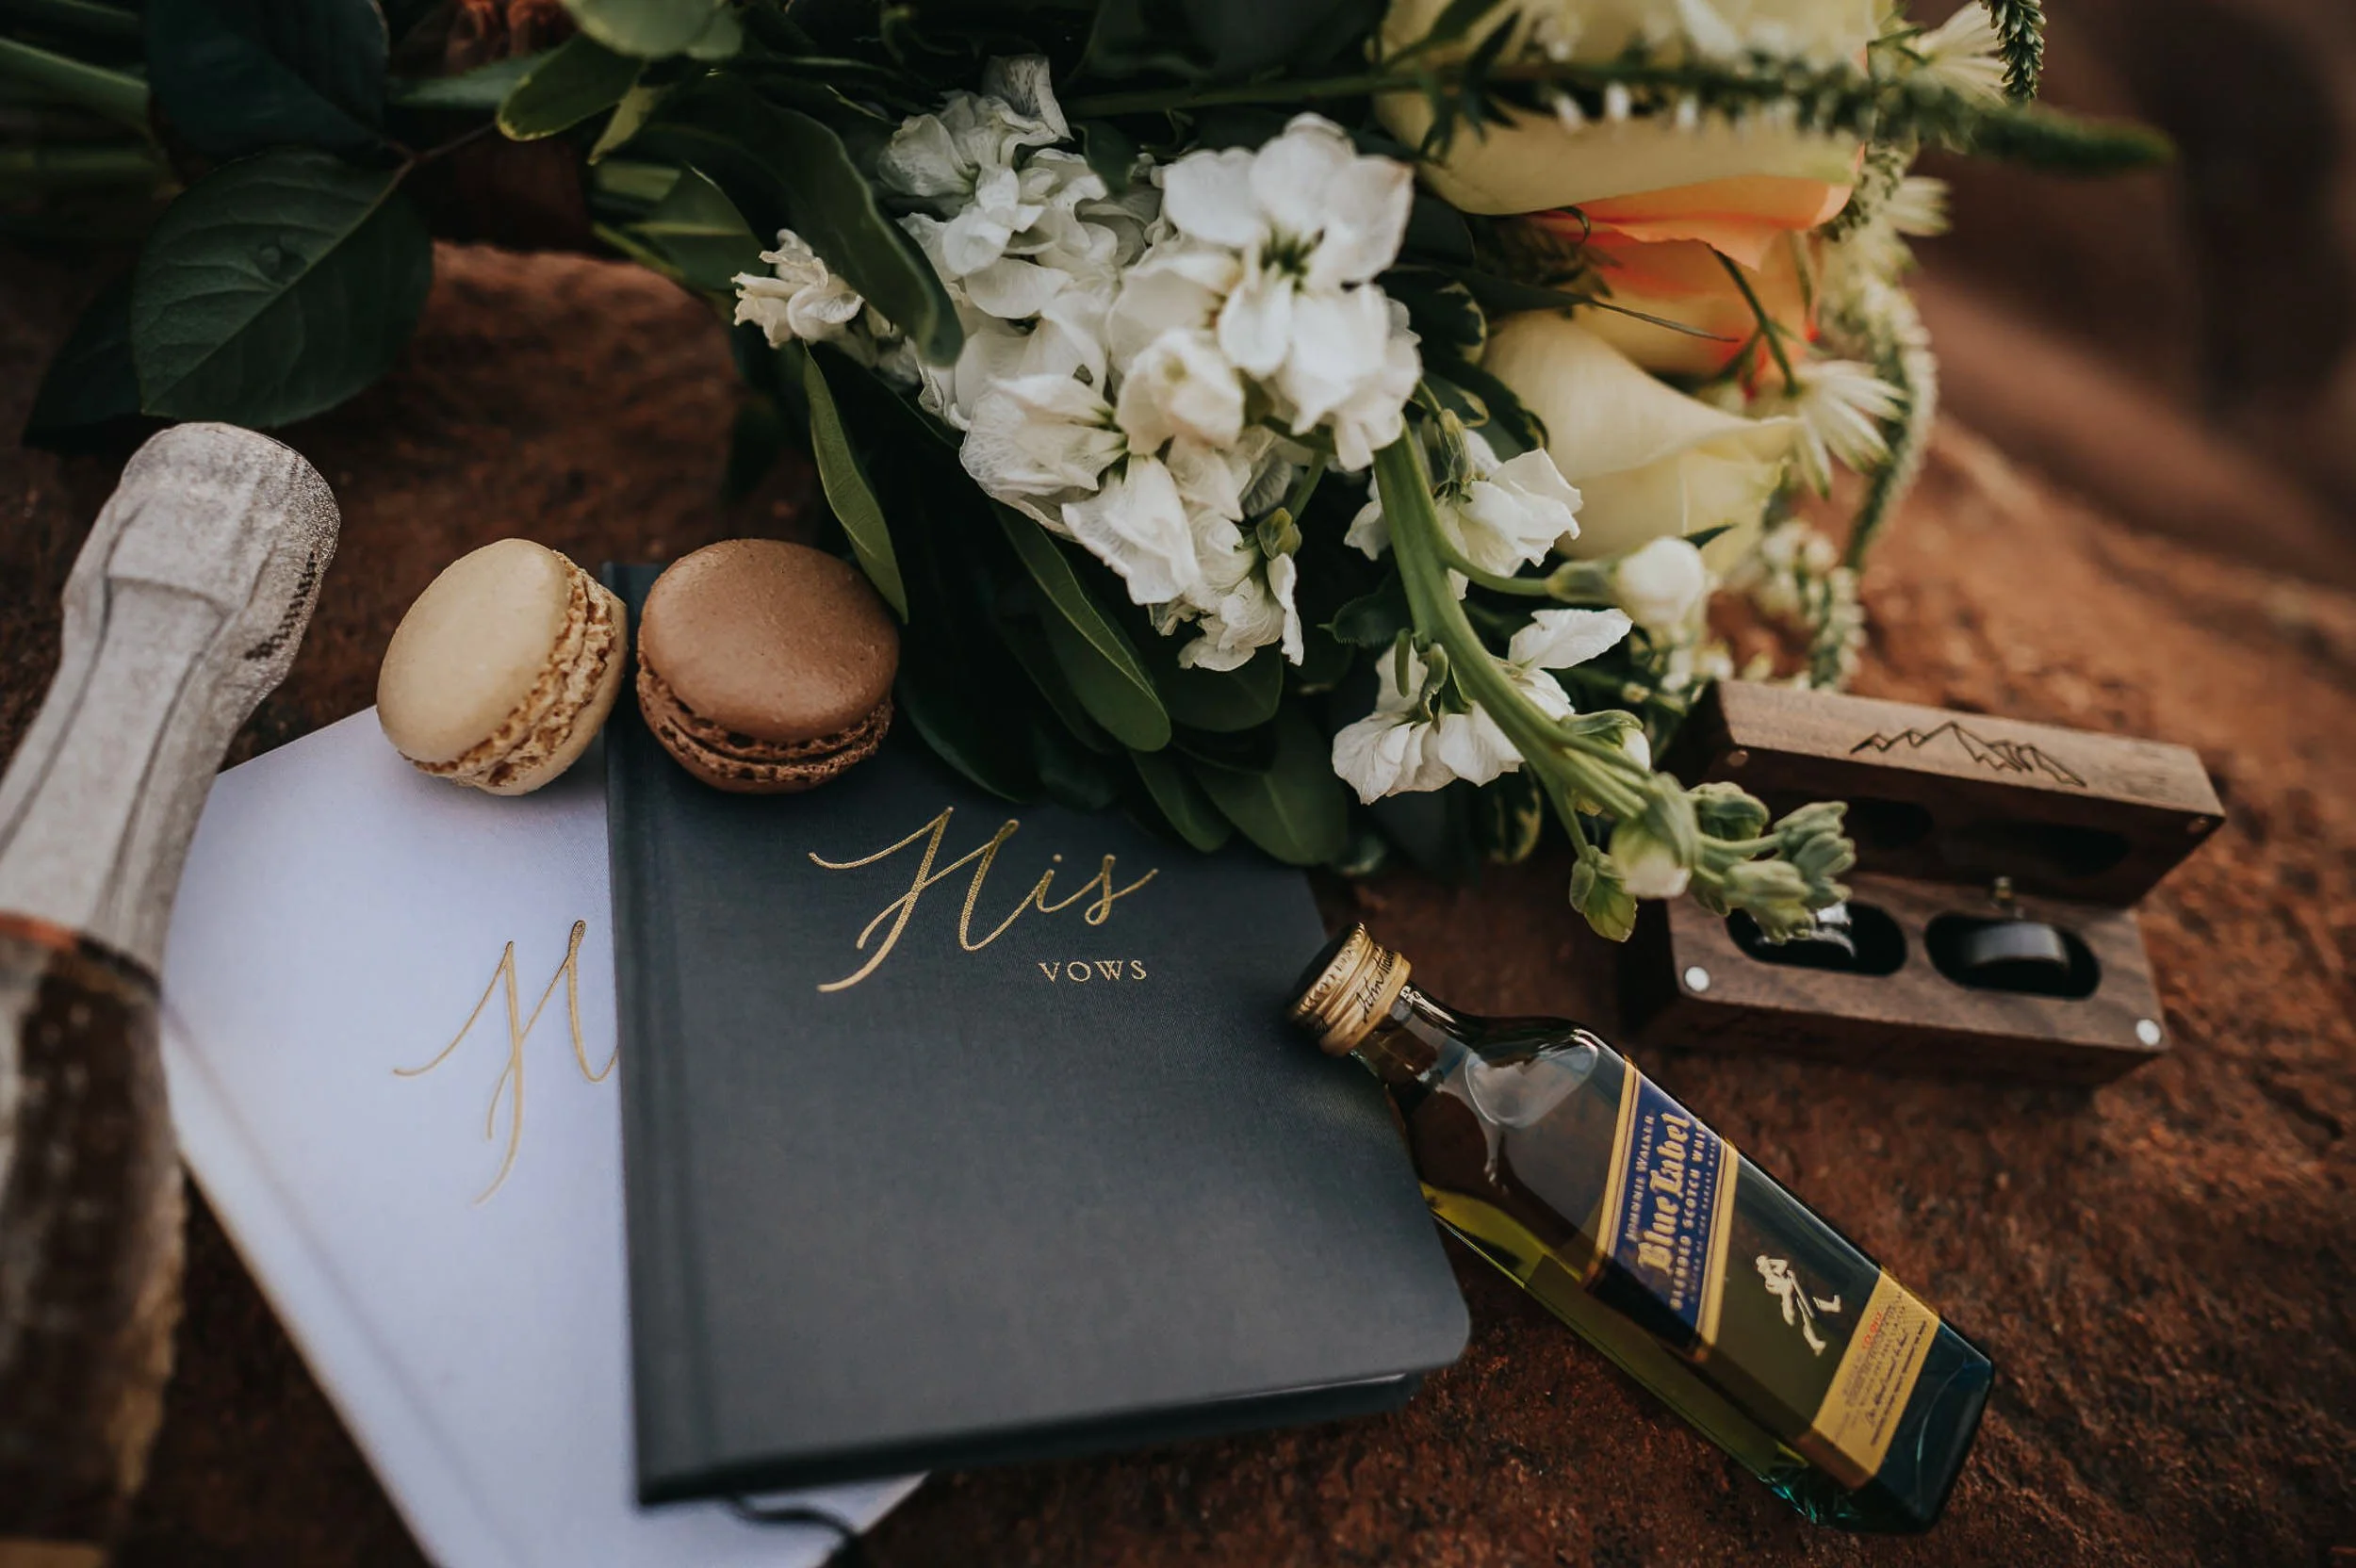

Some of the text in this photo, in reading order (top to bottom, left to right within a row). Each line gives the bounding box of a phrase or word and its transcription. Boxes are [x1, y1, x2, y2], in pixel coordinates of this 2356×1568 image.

[809, 806, 1159, 992] His
[1038, 959, 1148, 983] VOWS
[1637, 1112, 1692, 1278] Blue Label
[1681, 1168, 1702, 1229] SCOTCH
